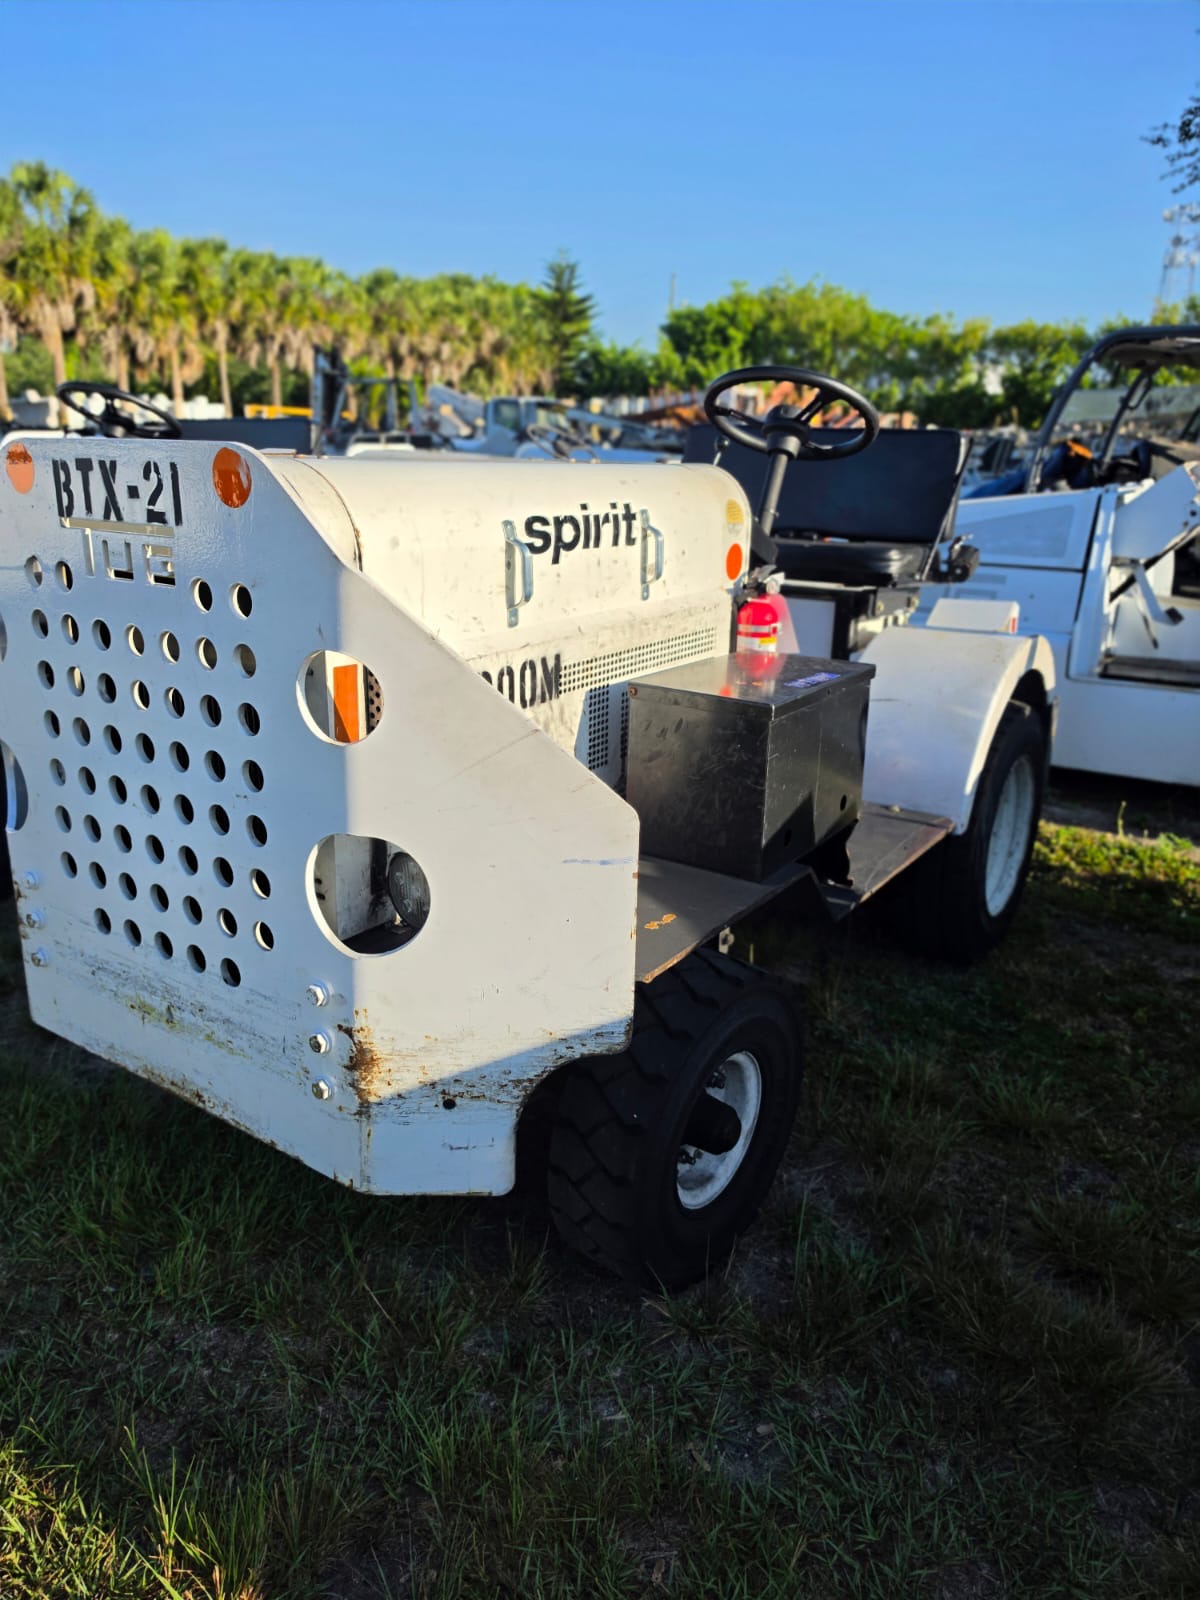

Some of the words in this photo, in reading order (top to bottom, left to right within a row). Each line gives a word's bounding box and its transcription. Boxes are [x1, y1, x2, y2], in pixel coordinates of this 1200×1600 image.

[52, 457, 183, 526] BTX-21
[523, 502, 637, 565] spirit
[478, 653, 561, 709] 00M
